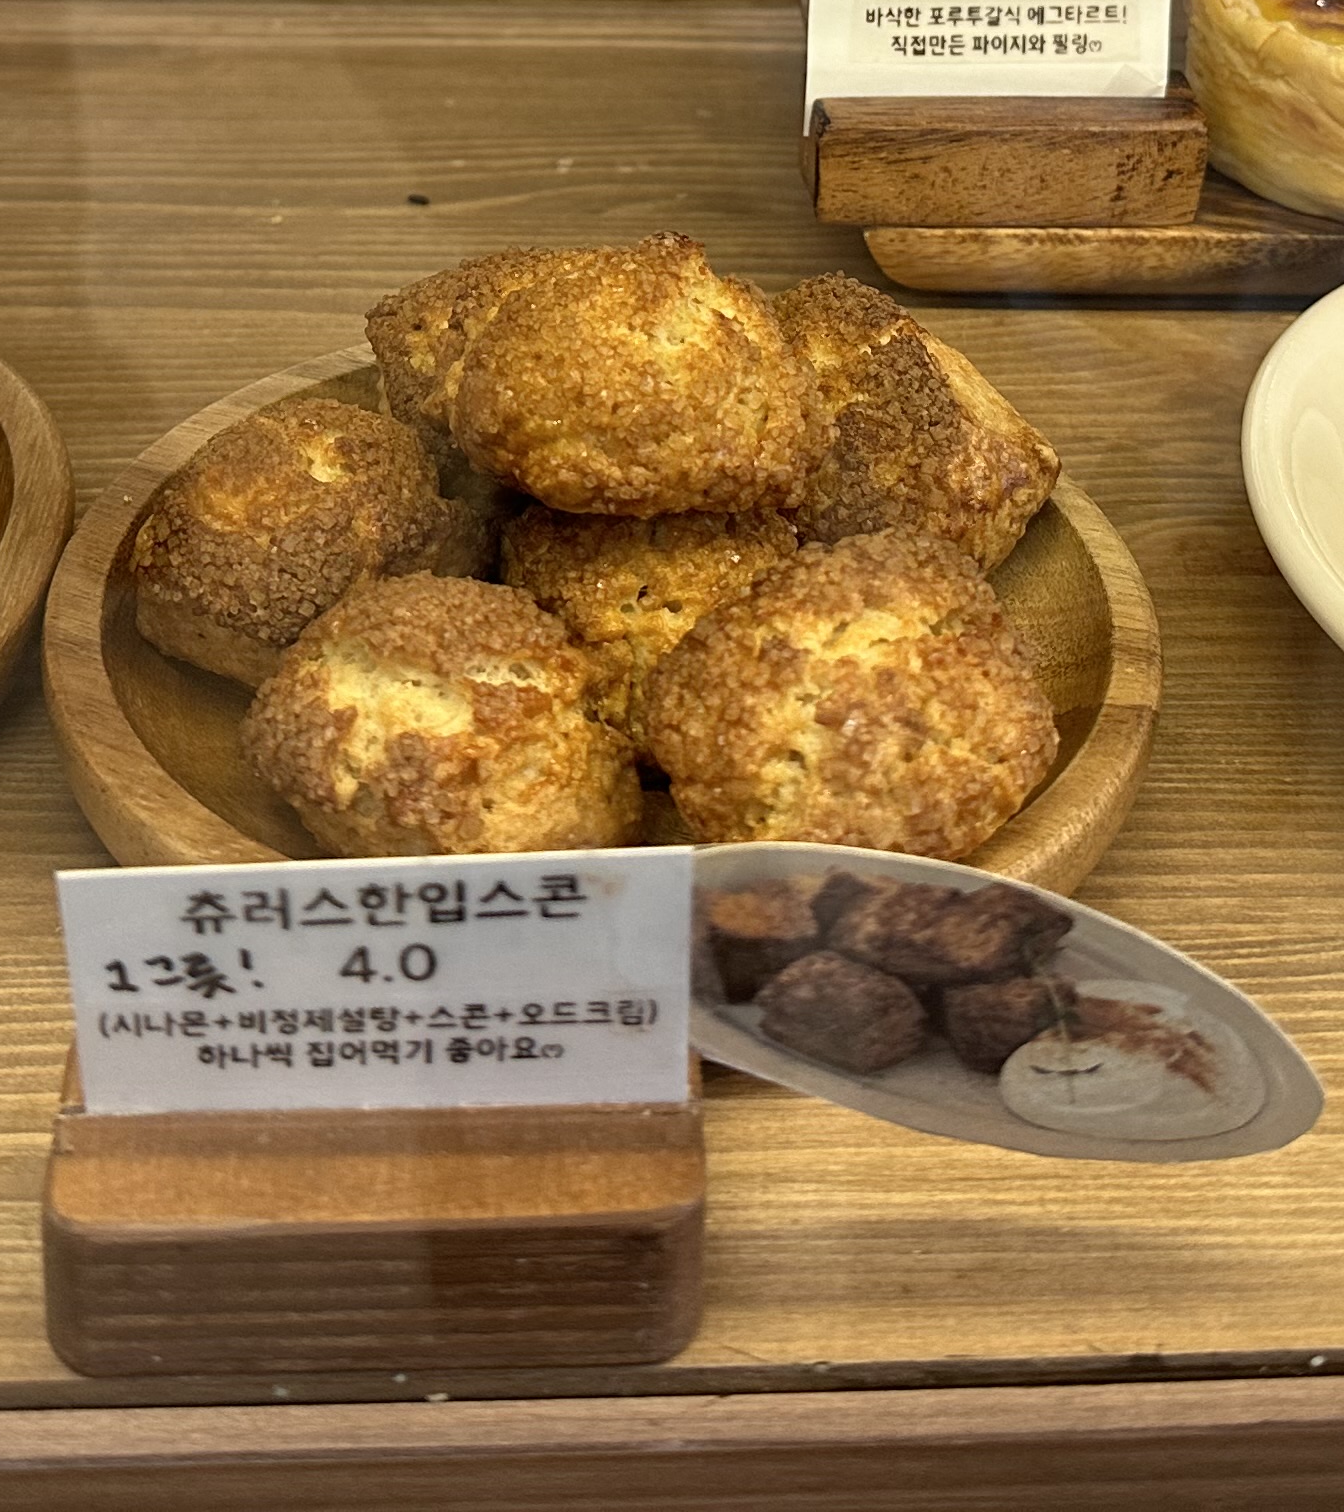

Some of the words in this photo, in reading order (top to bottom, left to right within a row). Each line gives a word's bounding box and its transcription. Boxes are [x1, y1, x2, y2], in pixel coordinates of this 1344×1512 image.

[865, 6, 922, 28] 바삭한
[1027, 5, 1127, 26] 에그타르트!
[891, 34, 965, 57] 직접만든
[972, 34, 1047, 55] 파이지와
[1052, 33, 1088, 56] 필링
[181, 873, 588, 935] 츄러스한입스콘
[339, 943, 439, 984] 4.0
[197, 1042, 293, 1070] 하나씩
[306, 1038, 434, 1068] 집어먹기
[445, 1036, 541, 1065] 좋아요
